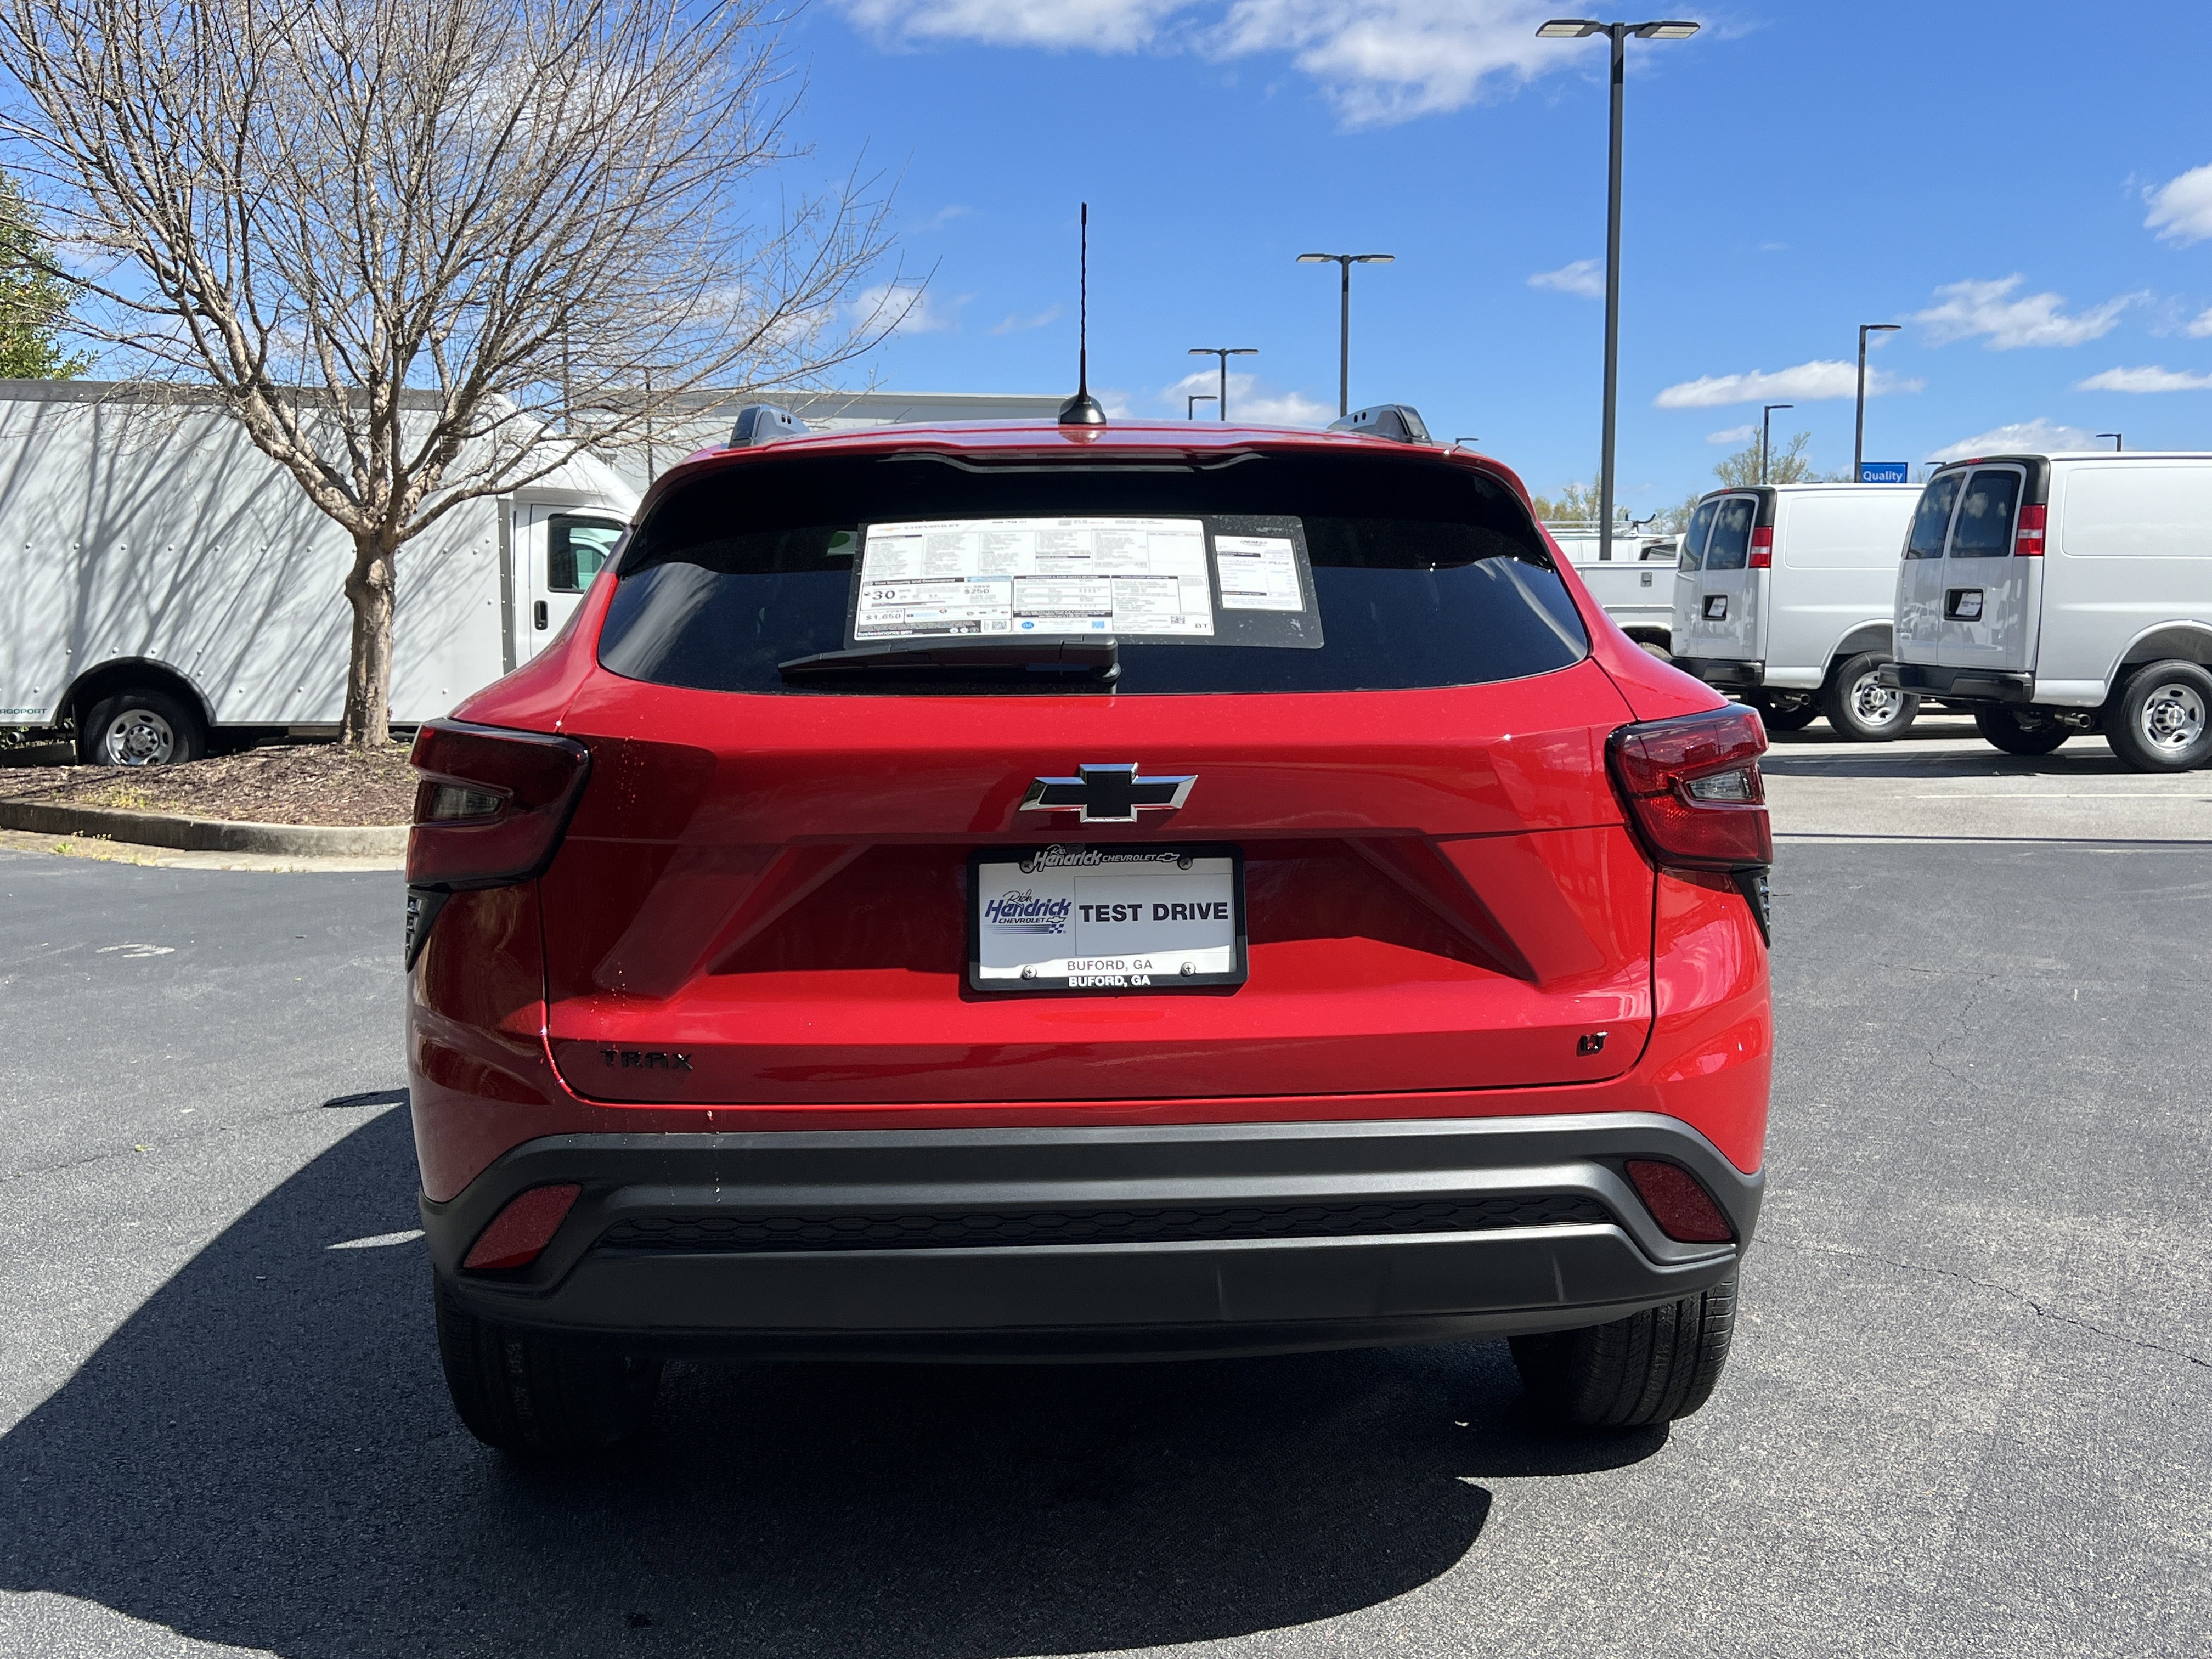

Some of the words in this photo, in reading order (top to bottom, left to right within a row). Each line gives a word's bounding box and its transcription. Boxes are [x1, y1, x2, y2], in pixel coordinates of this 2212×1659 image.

[1863, 471, 1903, 483] Quality
[872, 590, 895, 600] 30
[1033, 850, 1102, 872] Hendrick
[1102, 854, 1157, 863] CHEVROLET
[1002, 889, 1032, 907] Rick
[985, 898, 1072, 923] Hendrick
[1079, 904, 1142, 922] TEST
[1153, 902, 1228, 921] DRIVE
[1066, 960, 1128, 972] BUFORD,
[1133, 959, 1153, 970] GA
[1068, 975, 1127, 987] BUFORD,
[1131, 975, 1151, 986] GA
[600, 1049, 694, 1070] TRAX
